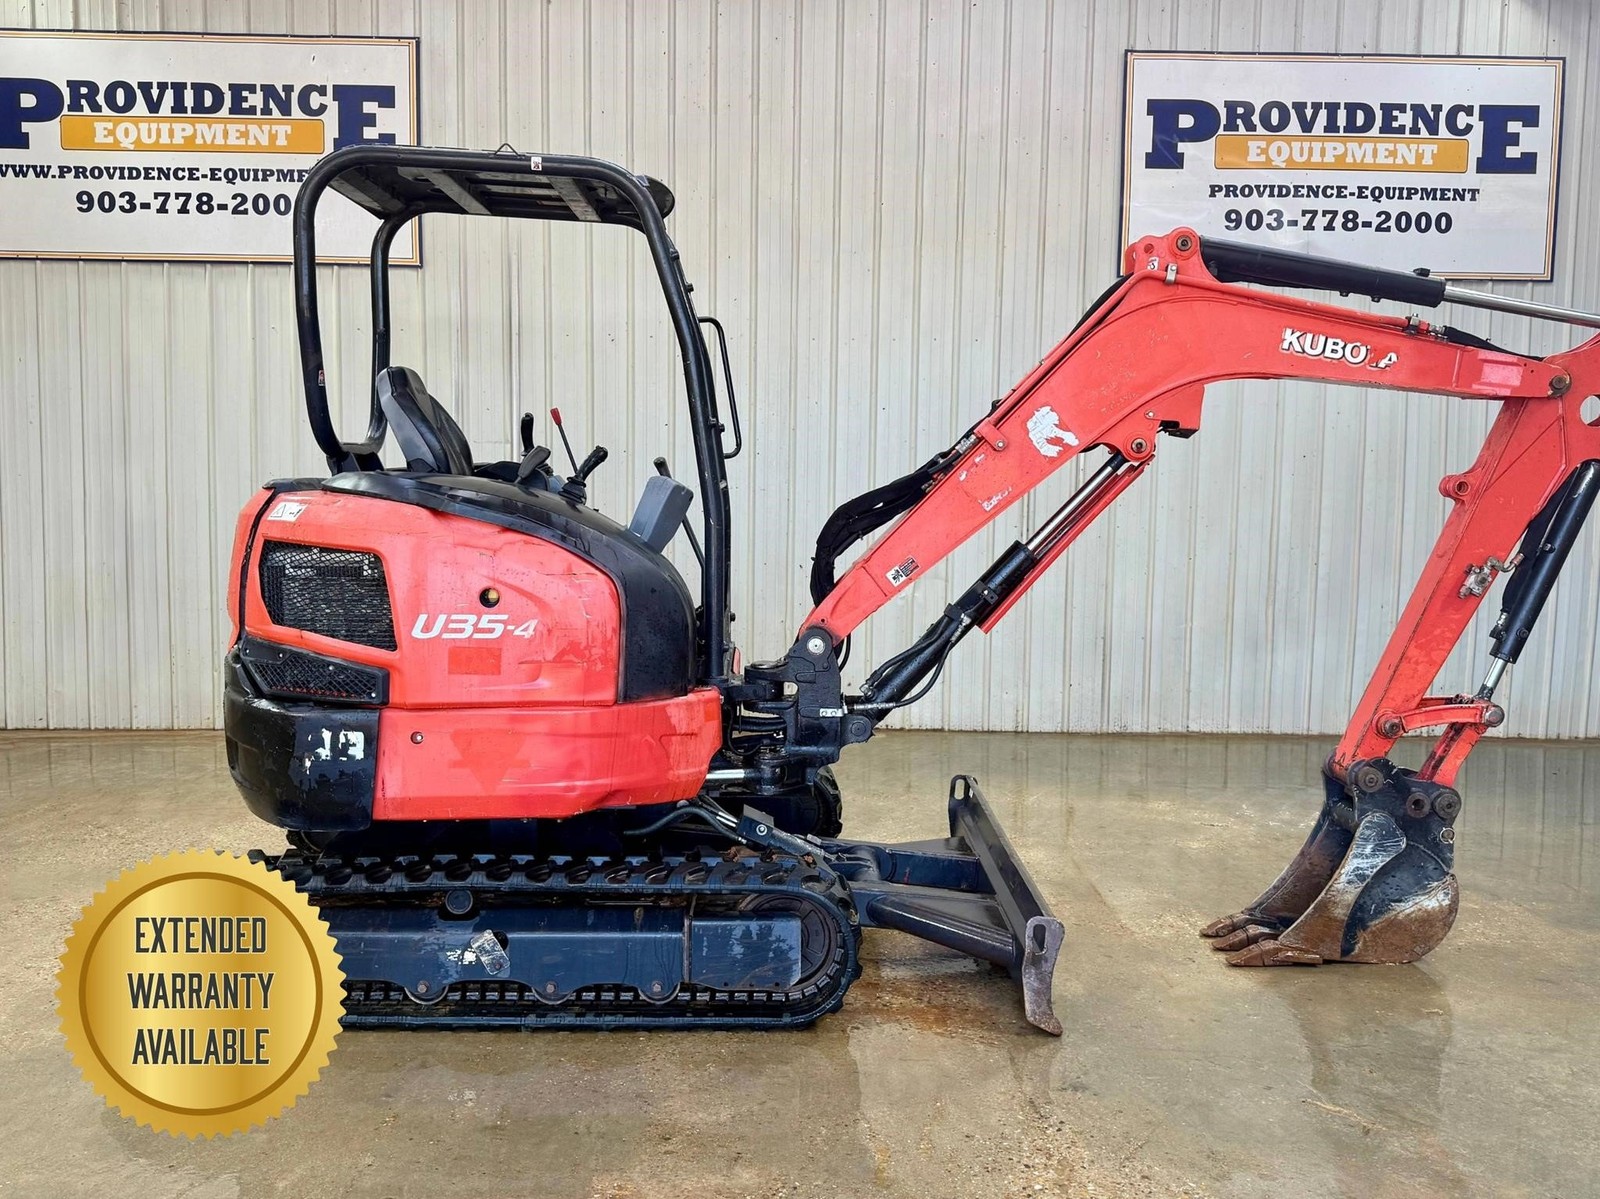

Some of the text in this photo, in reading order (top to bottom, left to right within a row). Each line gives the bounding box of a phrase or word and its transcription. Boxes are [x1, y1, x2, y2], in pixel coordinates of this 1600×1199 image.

[0, 77, 396, 151] PROVIDENCE
[94, 121, 292, 151] EQUIPMENT
[1144, 98, 1540, 174] PROVIDENCE
[1247, 140, 1438, 168] EQUIPMENT
[1208, 184, 1480, 202] PROVIDENCE-EQUIPMENT
[1224, 208, 1453, 234] 903-778-2000
[1281, 327, 1399, 370] KUBOA
[411, 613, 539, 640] U35-4
